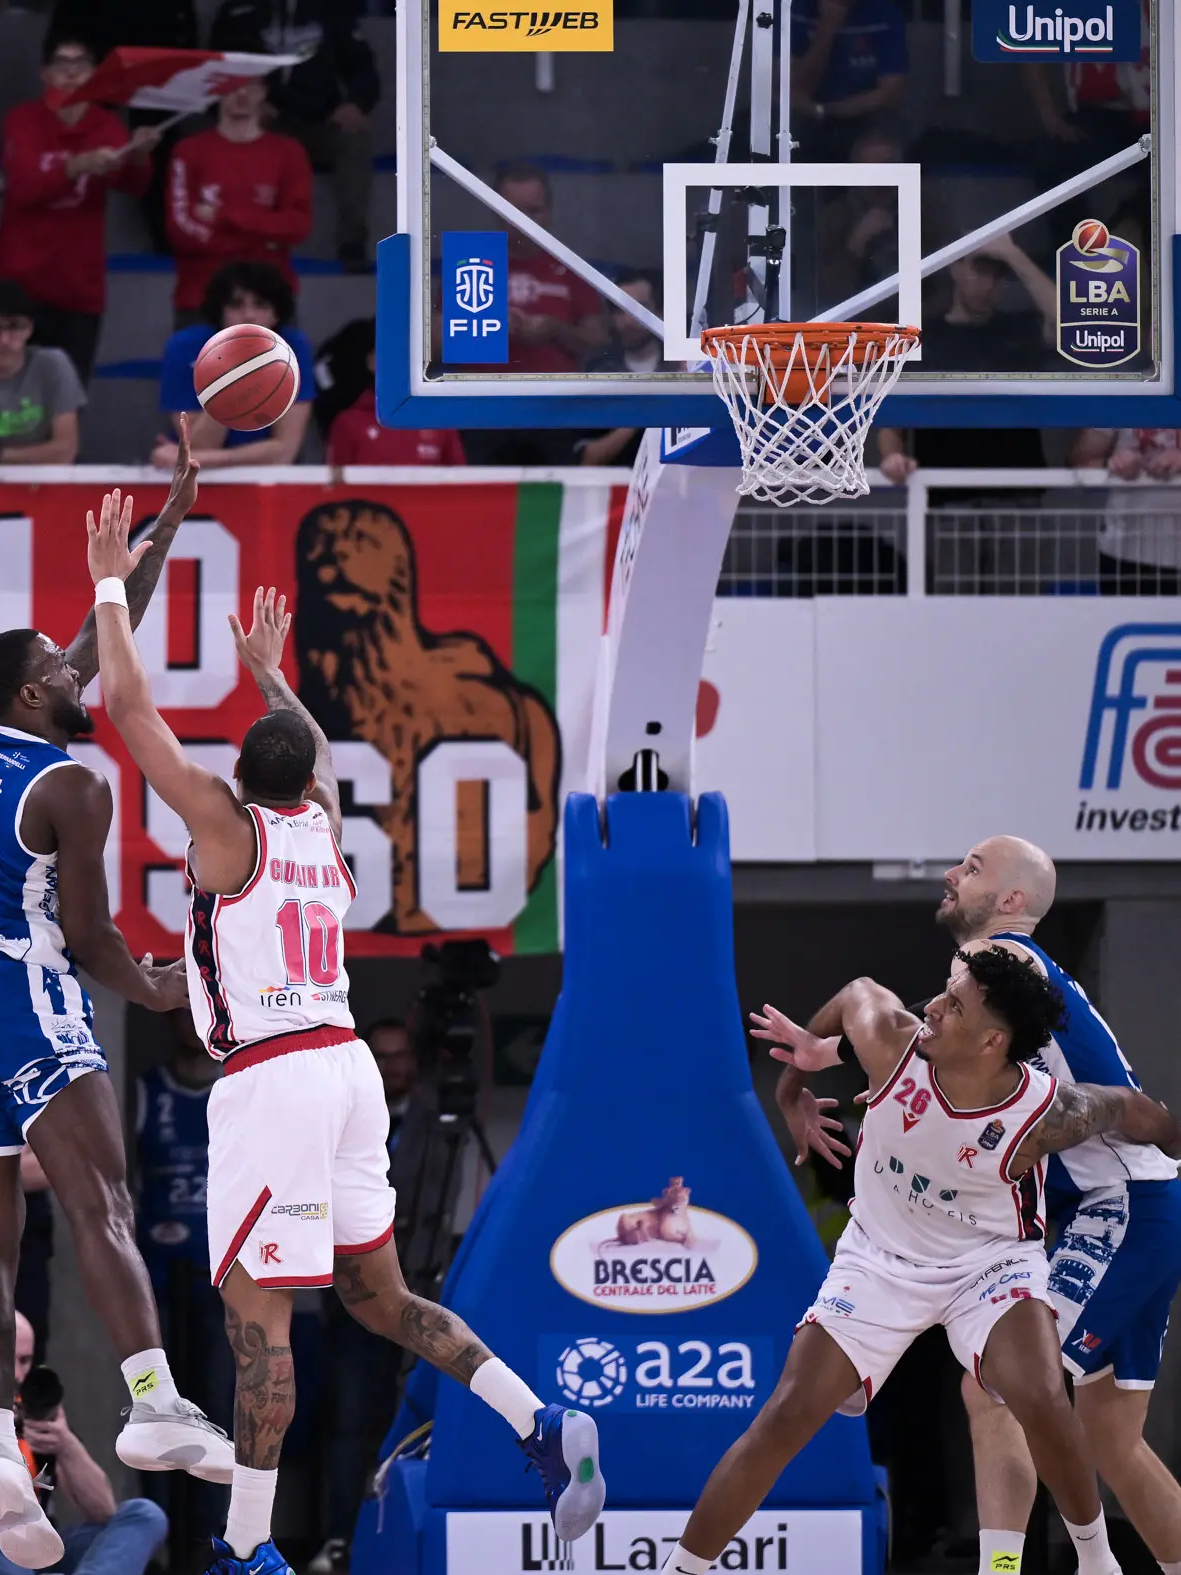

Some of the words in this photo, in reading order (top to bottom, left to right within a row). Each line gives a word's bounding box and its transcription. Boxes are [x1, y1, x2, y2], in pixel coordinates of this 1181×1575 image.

[452, 11, 599, 37] FASTWEB
[1008, 5, 1114, 53] Unipol
[1070, 280, 1131, 304] LBA
[1080, 307, 1109, 316] SERIE
[1111, 307, 1119, 316] A
[449, 319, 501, 338] FIP
[1076, 330, 1125, 353] Unipol
[275, 898, 339, 988] 10
[260, 990, 302, 1008] iren
[893, 1076, 933, 1116] 26
[593, 1257, 716, 1285] BRESCIA
[593, 1283, 654, 1297] CENTRALE
[656, 1284, 679, 1296] DEL
[682, 1283, 717, 1296] LATTE
[634, 1339, 756, 1390] a2a
[635, 1393, 669, 1408] LIFE
[671, 1393, 755, 1409] COMPANY
[596, 1521, 789, 1571] Laari
[995, 1563, 1016, 1571] PRS
